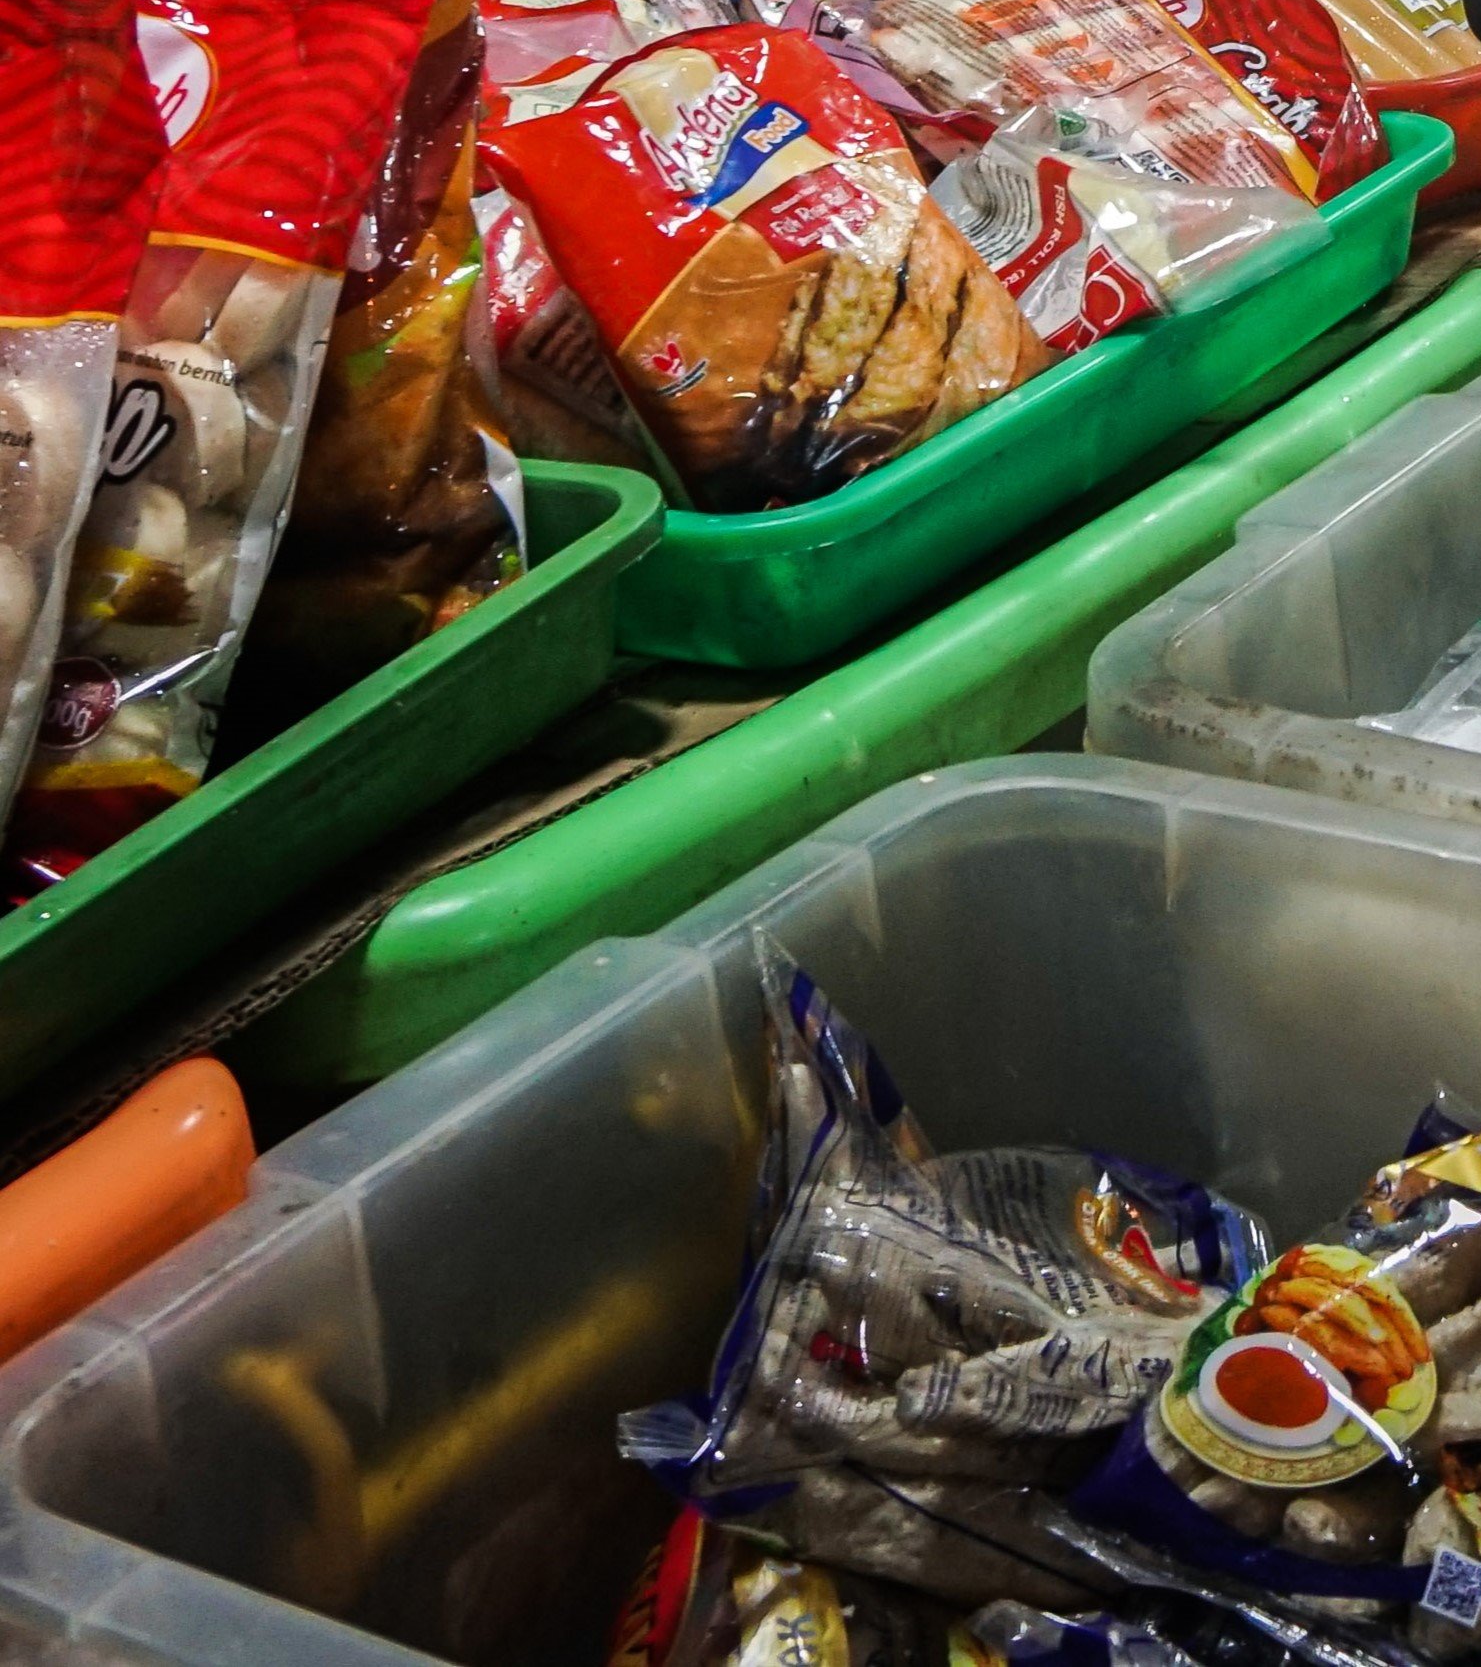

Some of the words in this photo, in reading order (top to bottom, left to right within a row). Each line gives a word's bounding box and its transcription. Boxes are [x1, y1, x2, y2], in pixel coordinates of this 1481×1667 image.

[742, 106, 802, 153] Food
[1053, 184, 1066, 226] FISH
[1027, 227, 1063, 267] ROLL
